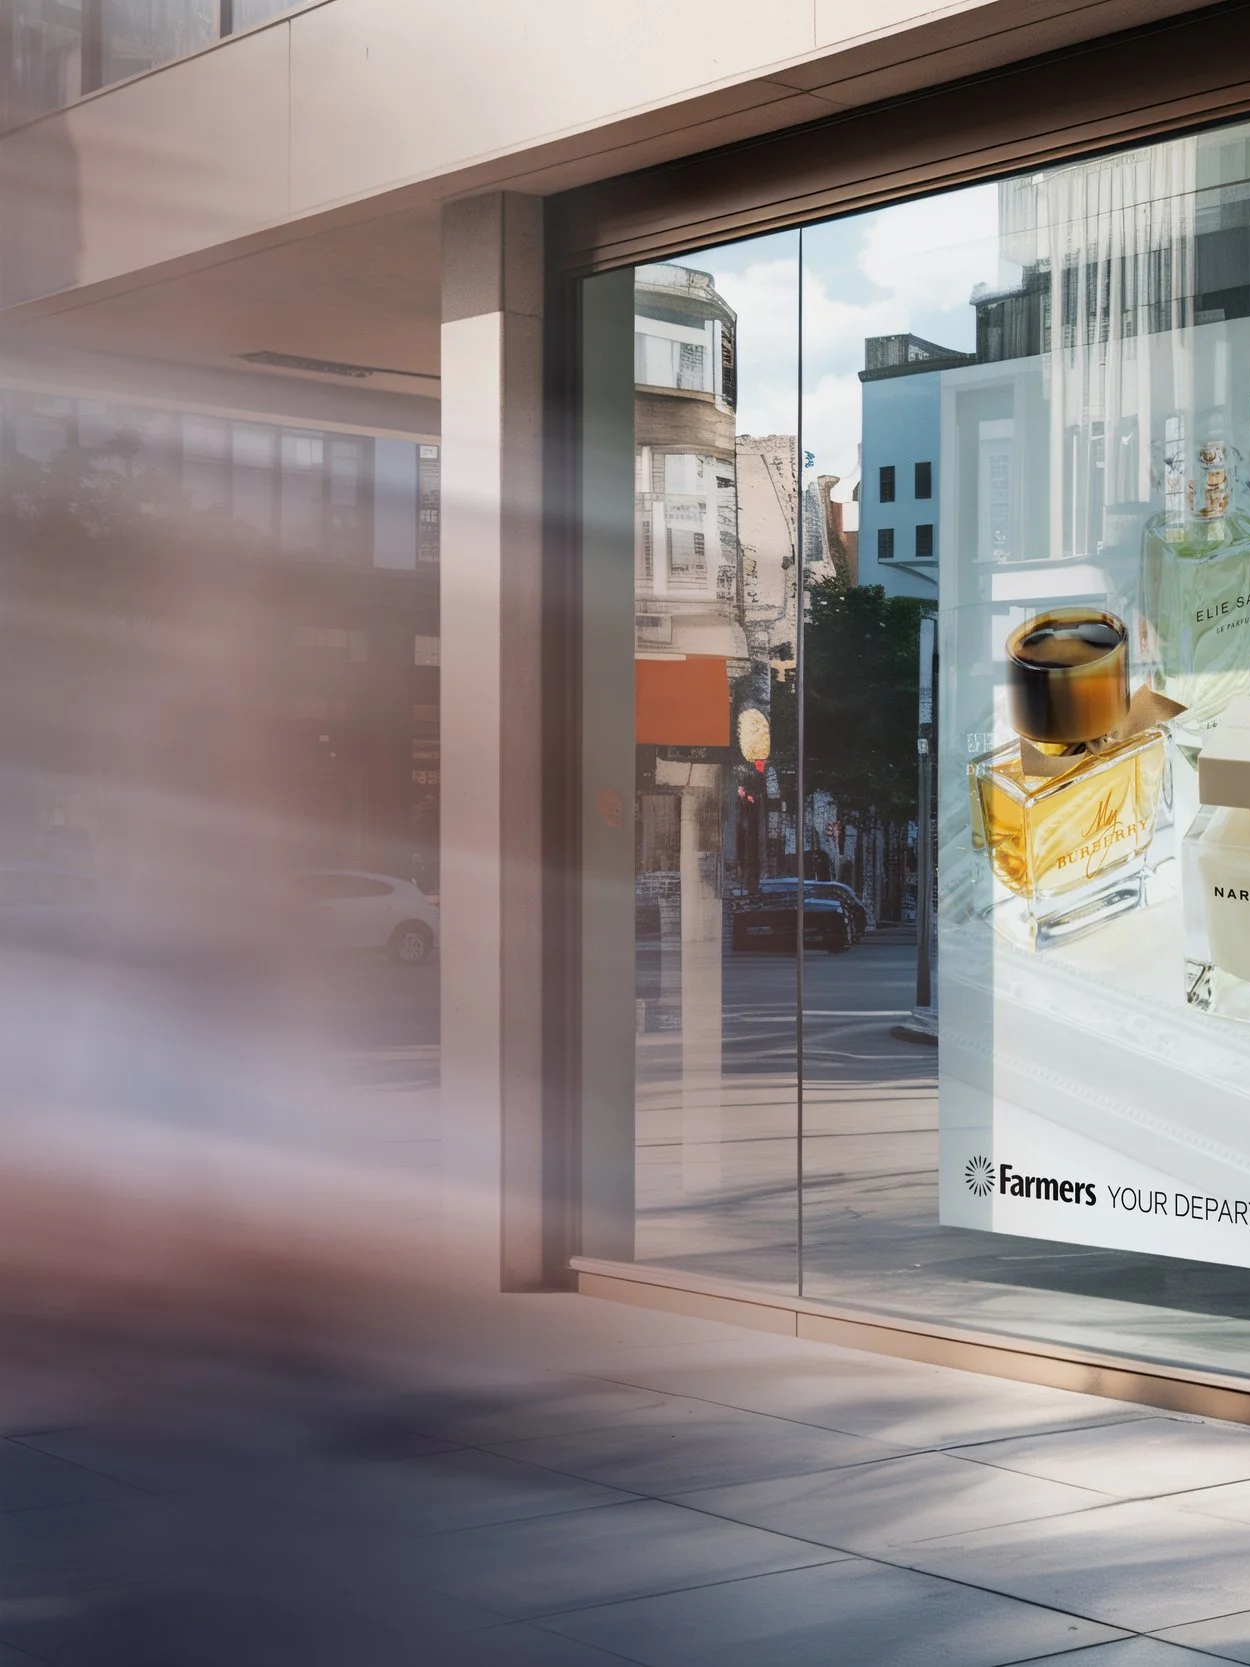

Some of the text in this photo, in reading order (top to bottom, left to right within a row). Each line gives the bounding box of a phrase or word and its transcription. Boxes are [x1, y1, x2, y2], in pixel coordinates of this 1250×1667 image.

[1196, 601, 1229, 622] ELIE
[1216, 625, 1225, 634] LE
[1056, 820, 1146, 869] BURBERRY
[999, 1163, 1097, 1206] Farmers
[1108, 1185, 1168, 1216] YOUR
